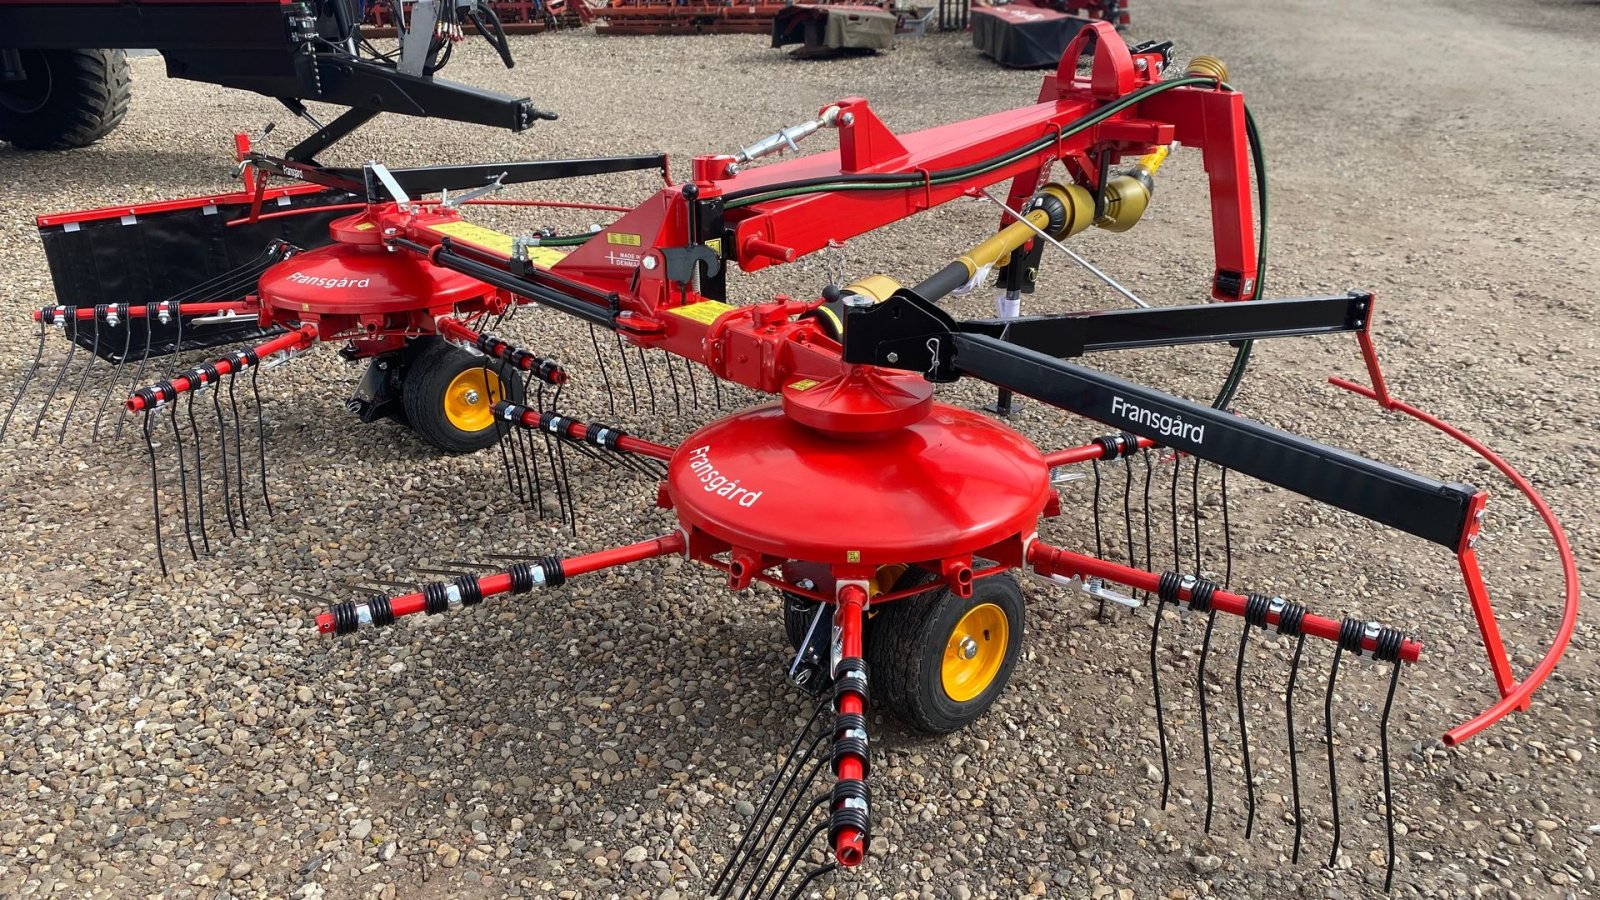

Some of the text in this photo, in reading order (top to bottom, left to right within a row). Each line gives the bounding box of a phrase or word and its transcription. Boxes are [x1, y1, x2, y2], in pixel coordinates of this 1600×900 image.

[619, 252, 635, 260] MADE
[286, 271, 370, 289] Fransgård
[1111, 395, 1205, 445] Fransgård
[689, 445, 764, 508] Fransgård
